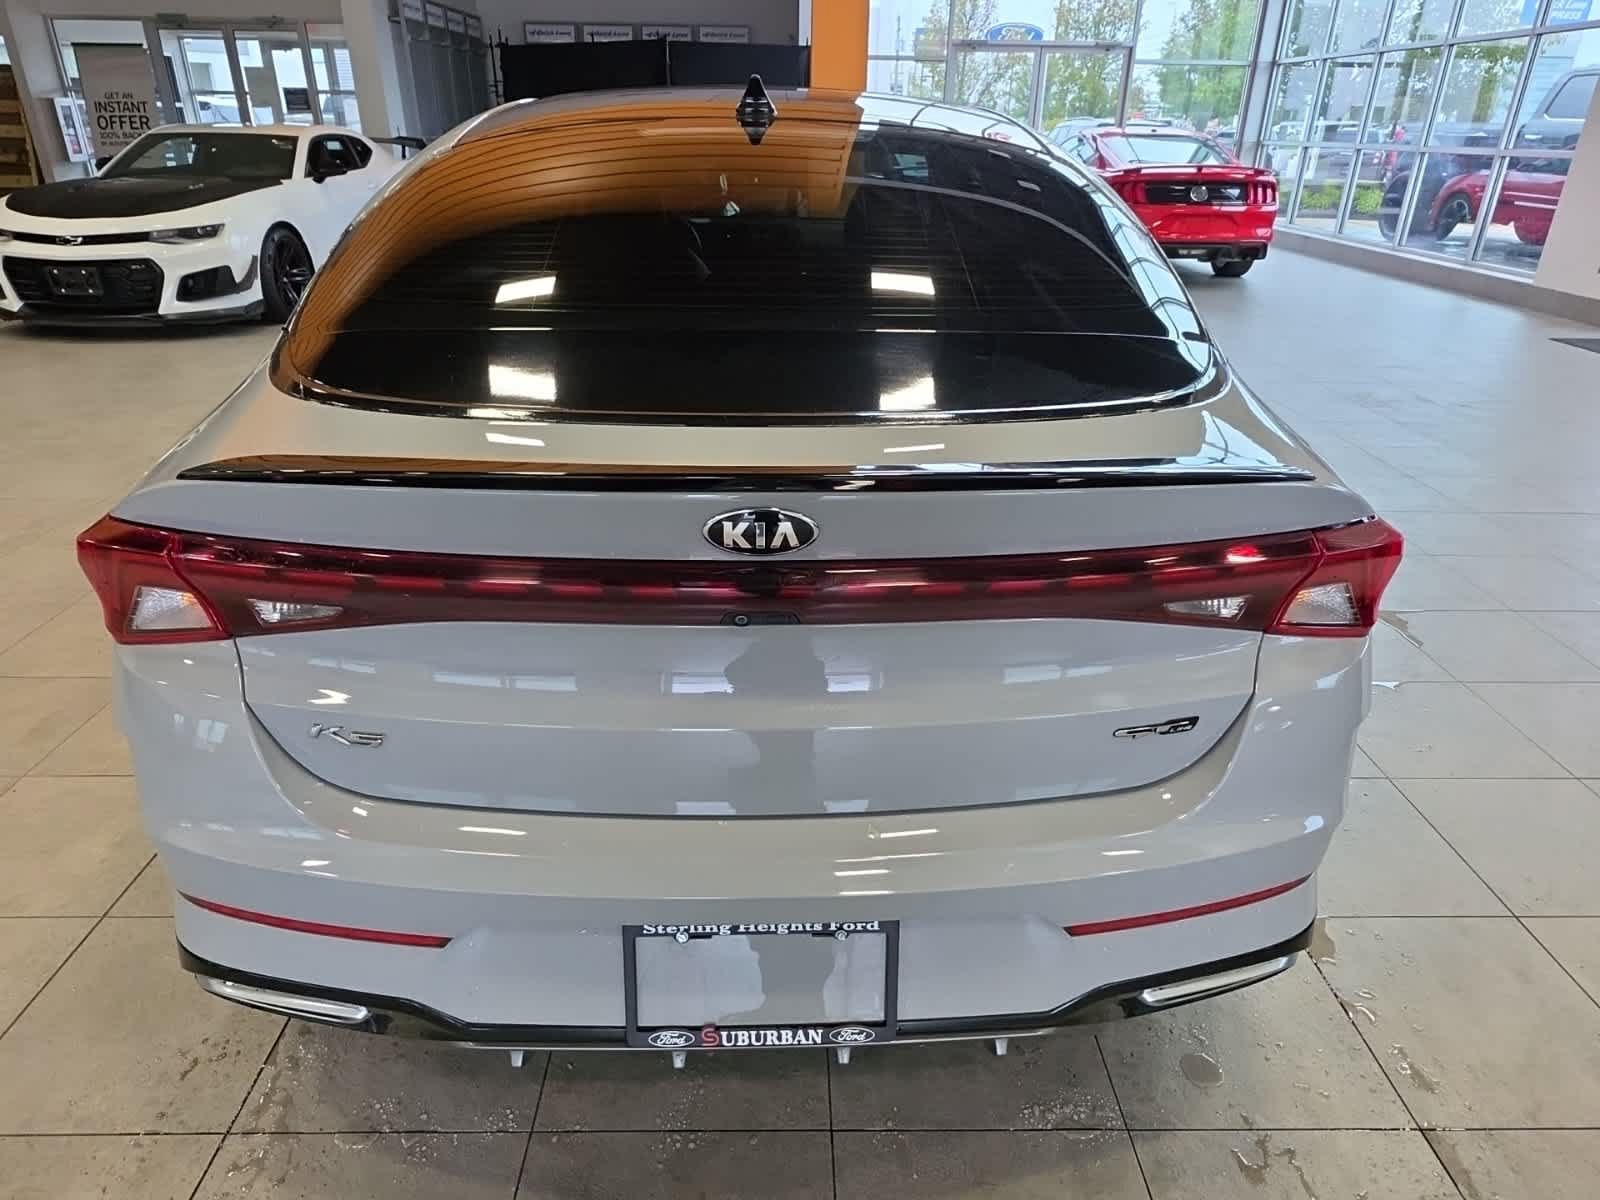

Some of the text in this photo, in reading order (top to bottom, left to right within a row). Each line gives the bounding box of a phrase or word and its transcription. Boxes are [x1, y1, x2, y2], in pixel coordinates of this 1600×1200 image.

[104, 91, 134, 99] GET AN
[94, 100, 148, 113] INSTANT
[97, 114, 151, 130] OFFER
[721, 520, 801, 549] KIA
[642, 919, 881, 936] Sterling Heights Ford
[701, 1026, 824, 1047] SUBURBAN
